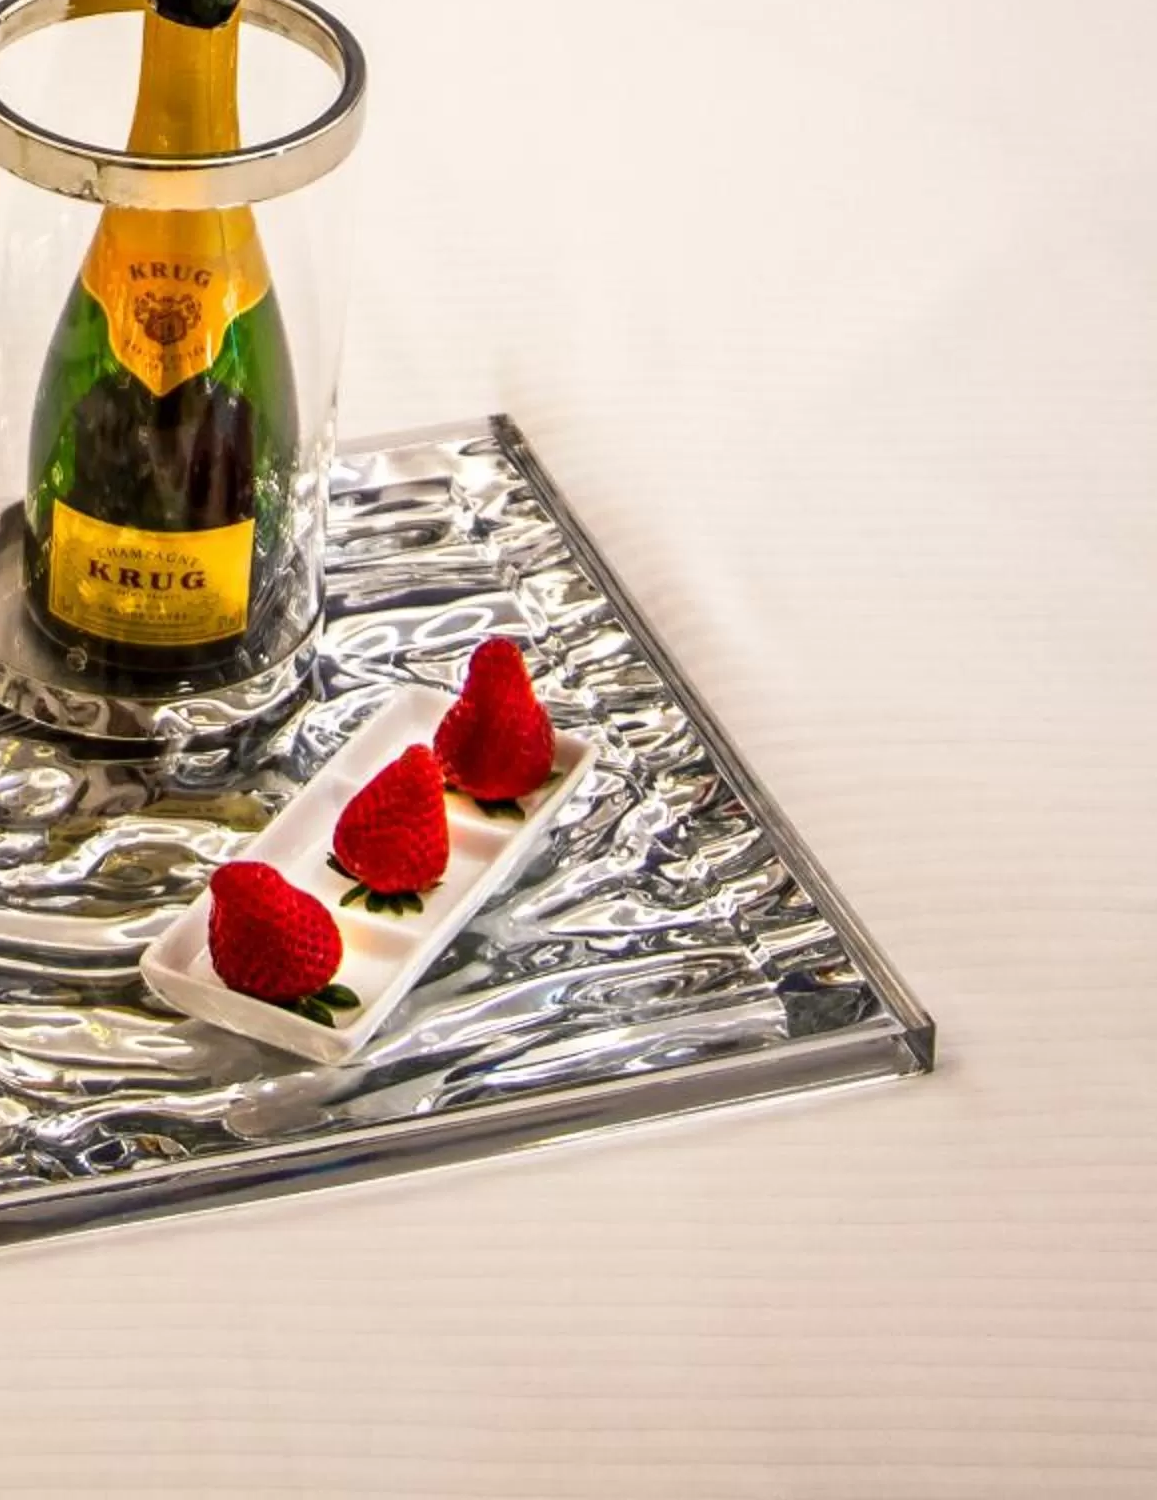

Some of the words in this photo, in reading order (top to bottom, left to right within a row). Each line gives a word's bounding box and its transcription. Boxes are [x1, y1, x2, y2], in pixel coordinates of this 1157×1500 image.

[129, 261, 213, 288] KRUG
[96, 547, 201, 568] CHAMPAGNE
[88, 558, 207, 591] KRUG
